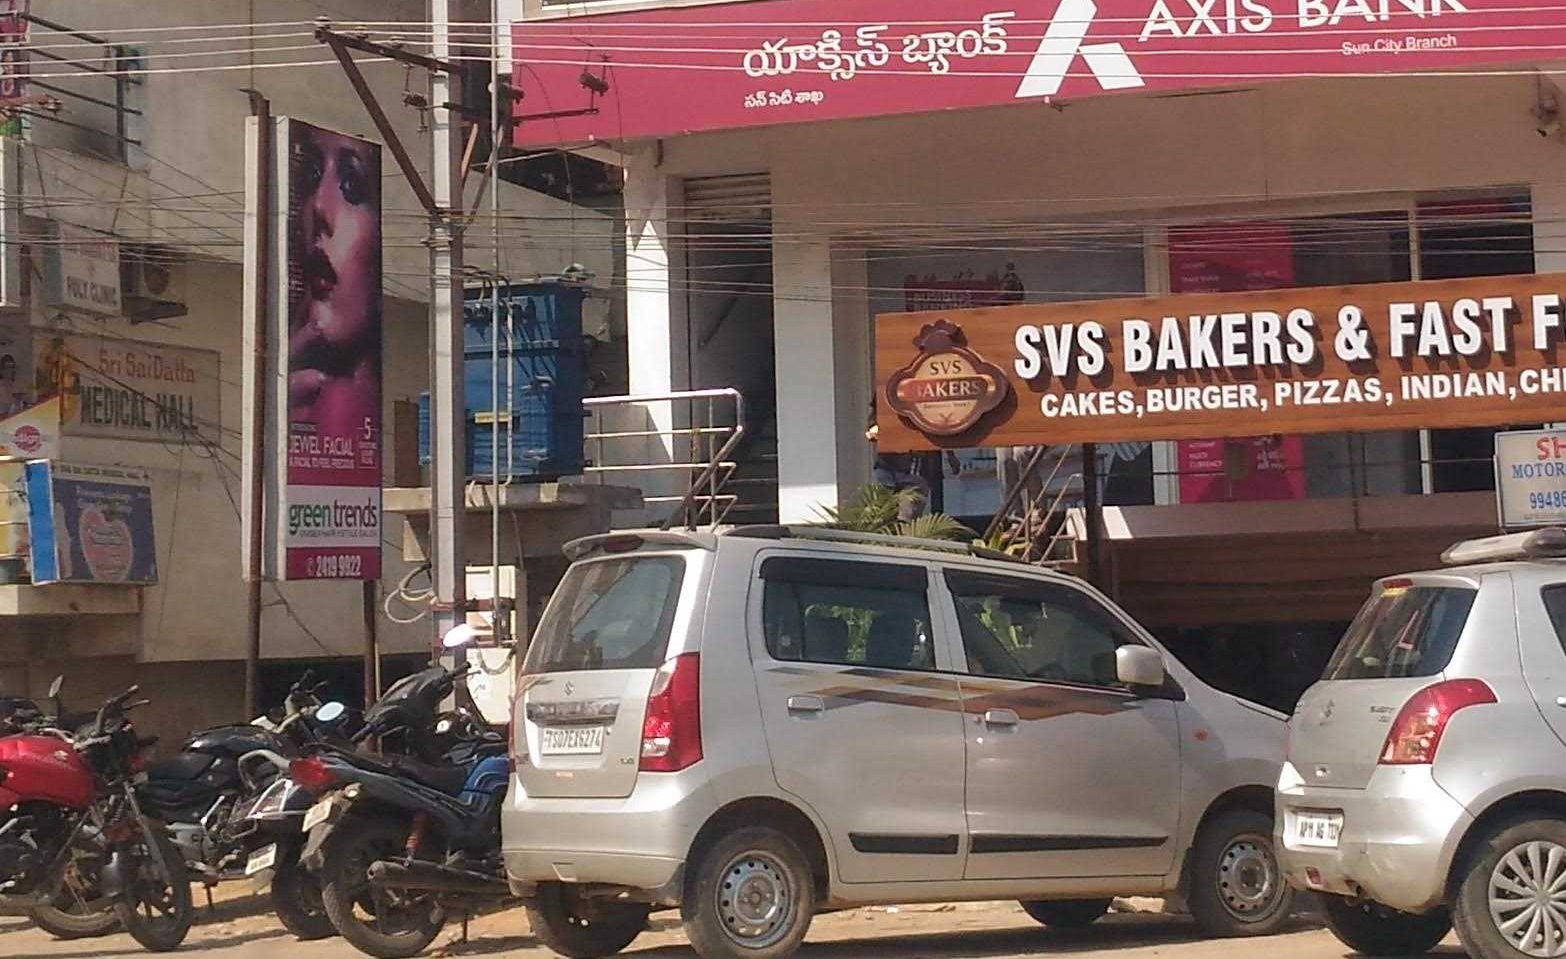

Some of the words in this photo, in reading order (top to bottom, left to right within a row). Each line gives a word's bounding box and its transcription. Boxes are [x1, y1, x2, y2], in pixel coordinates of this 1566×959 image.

[1373, 37, 1403, 54] City
[1404, 33, 1458, 50] Branch
[1014, 320, 1104, 379] SVS
[1122, 306, 1315, 374] BAKERS
[1334, 302, 1372, 362] &
[1388, 297, 1513, 358] FAST
[929, 360, 962, 376] SVS
[79, 384, 151, 428] MEDICAL
[288, 433, 321, 454] JEWEL
[323, 435, 355, 456] FACIAL
[1512, 461, 1566, 480] MOTOR
[288, 503, 331, 535] green
[333, 497, 377, 528] trends
